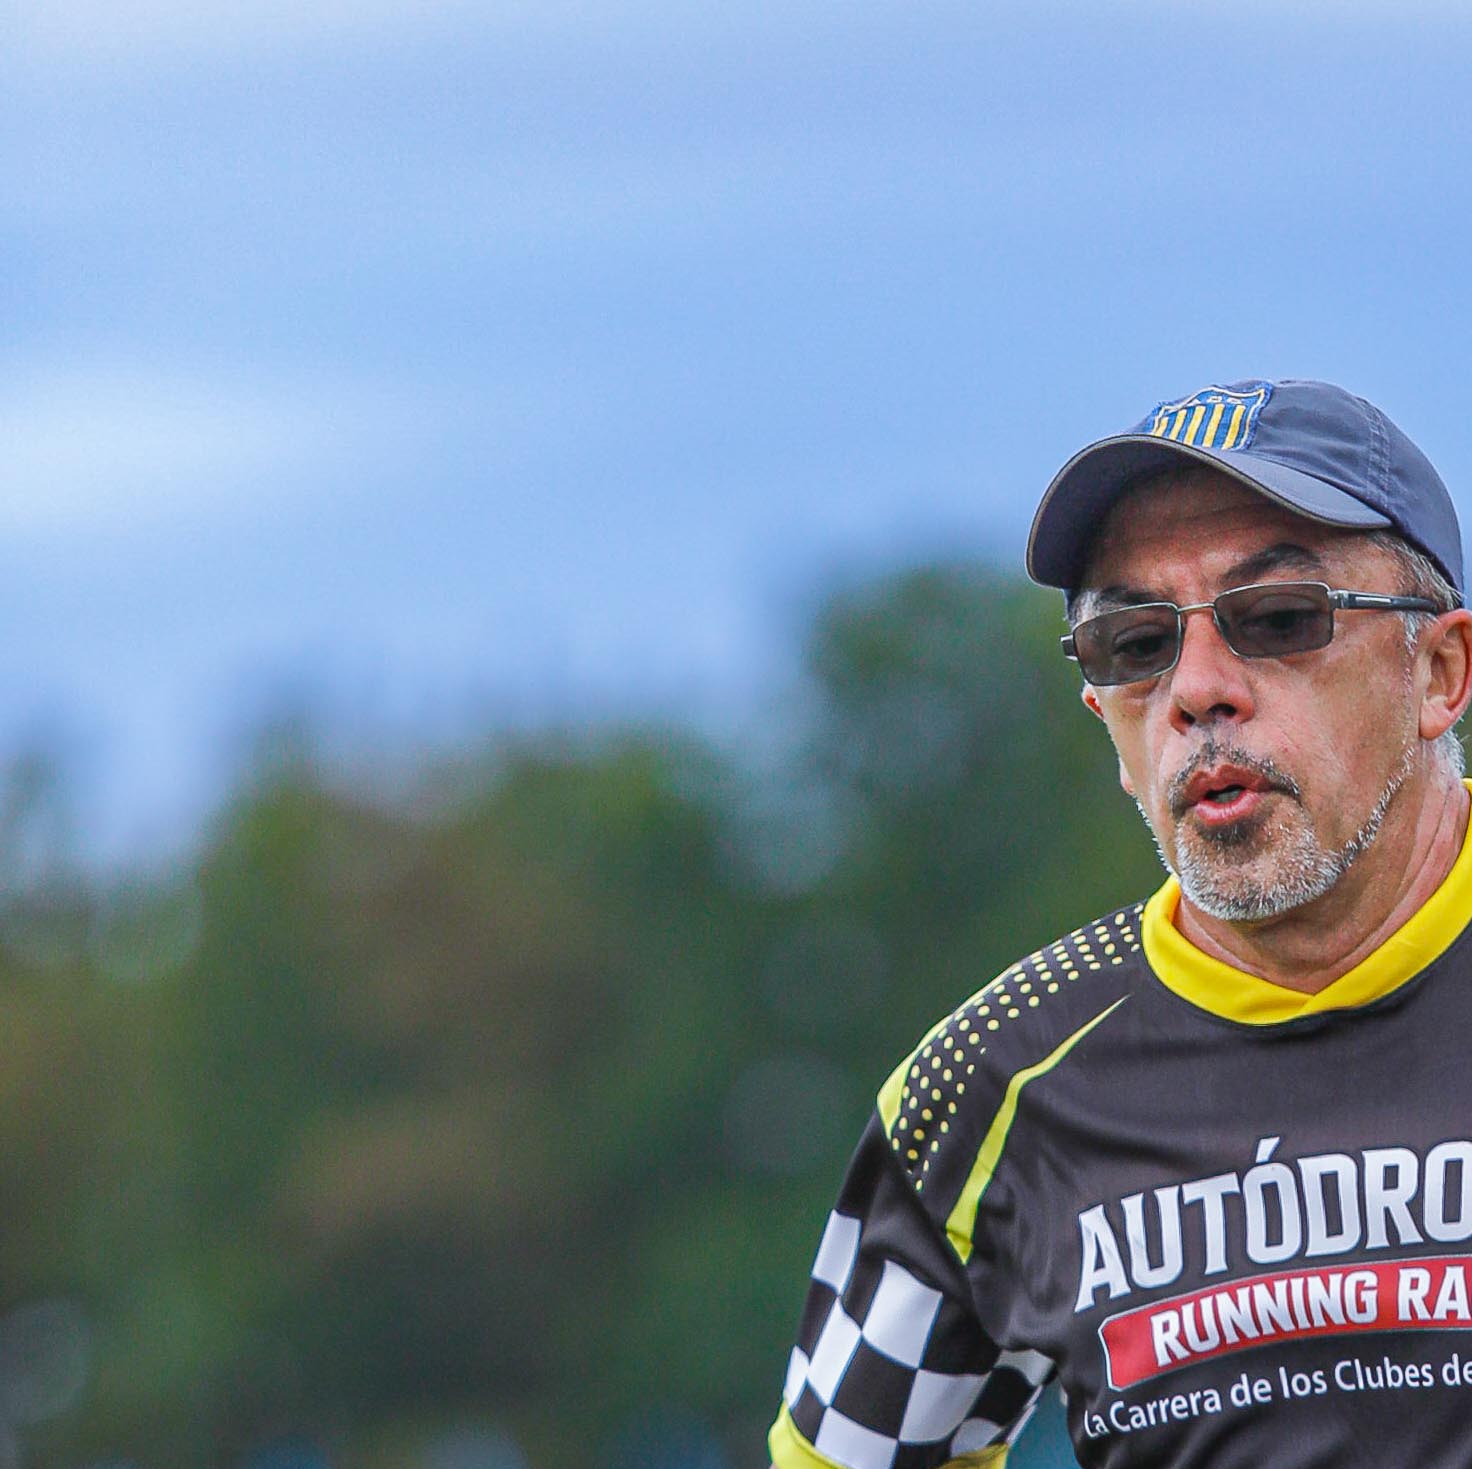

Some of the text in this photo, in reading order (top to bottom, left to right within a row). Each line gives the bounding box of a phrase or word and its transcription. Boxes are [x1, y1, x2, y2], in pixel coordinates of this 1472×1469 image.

[1150, 1270, 1377, 1367] RUNNING
[1110, 1387, 1223, 1432] Carrera
[1231, 1373, 1272, 1407] de
[1279, 1366, 1327, 1399] los
[1335, 1357, 1435, 1391] Clubes
